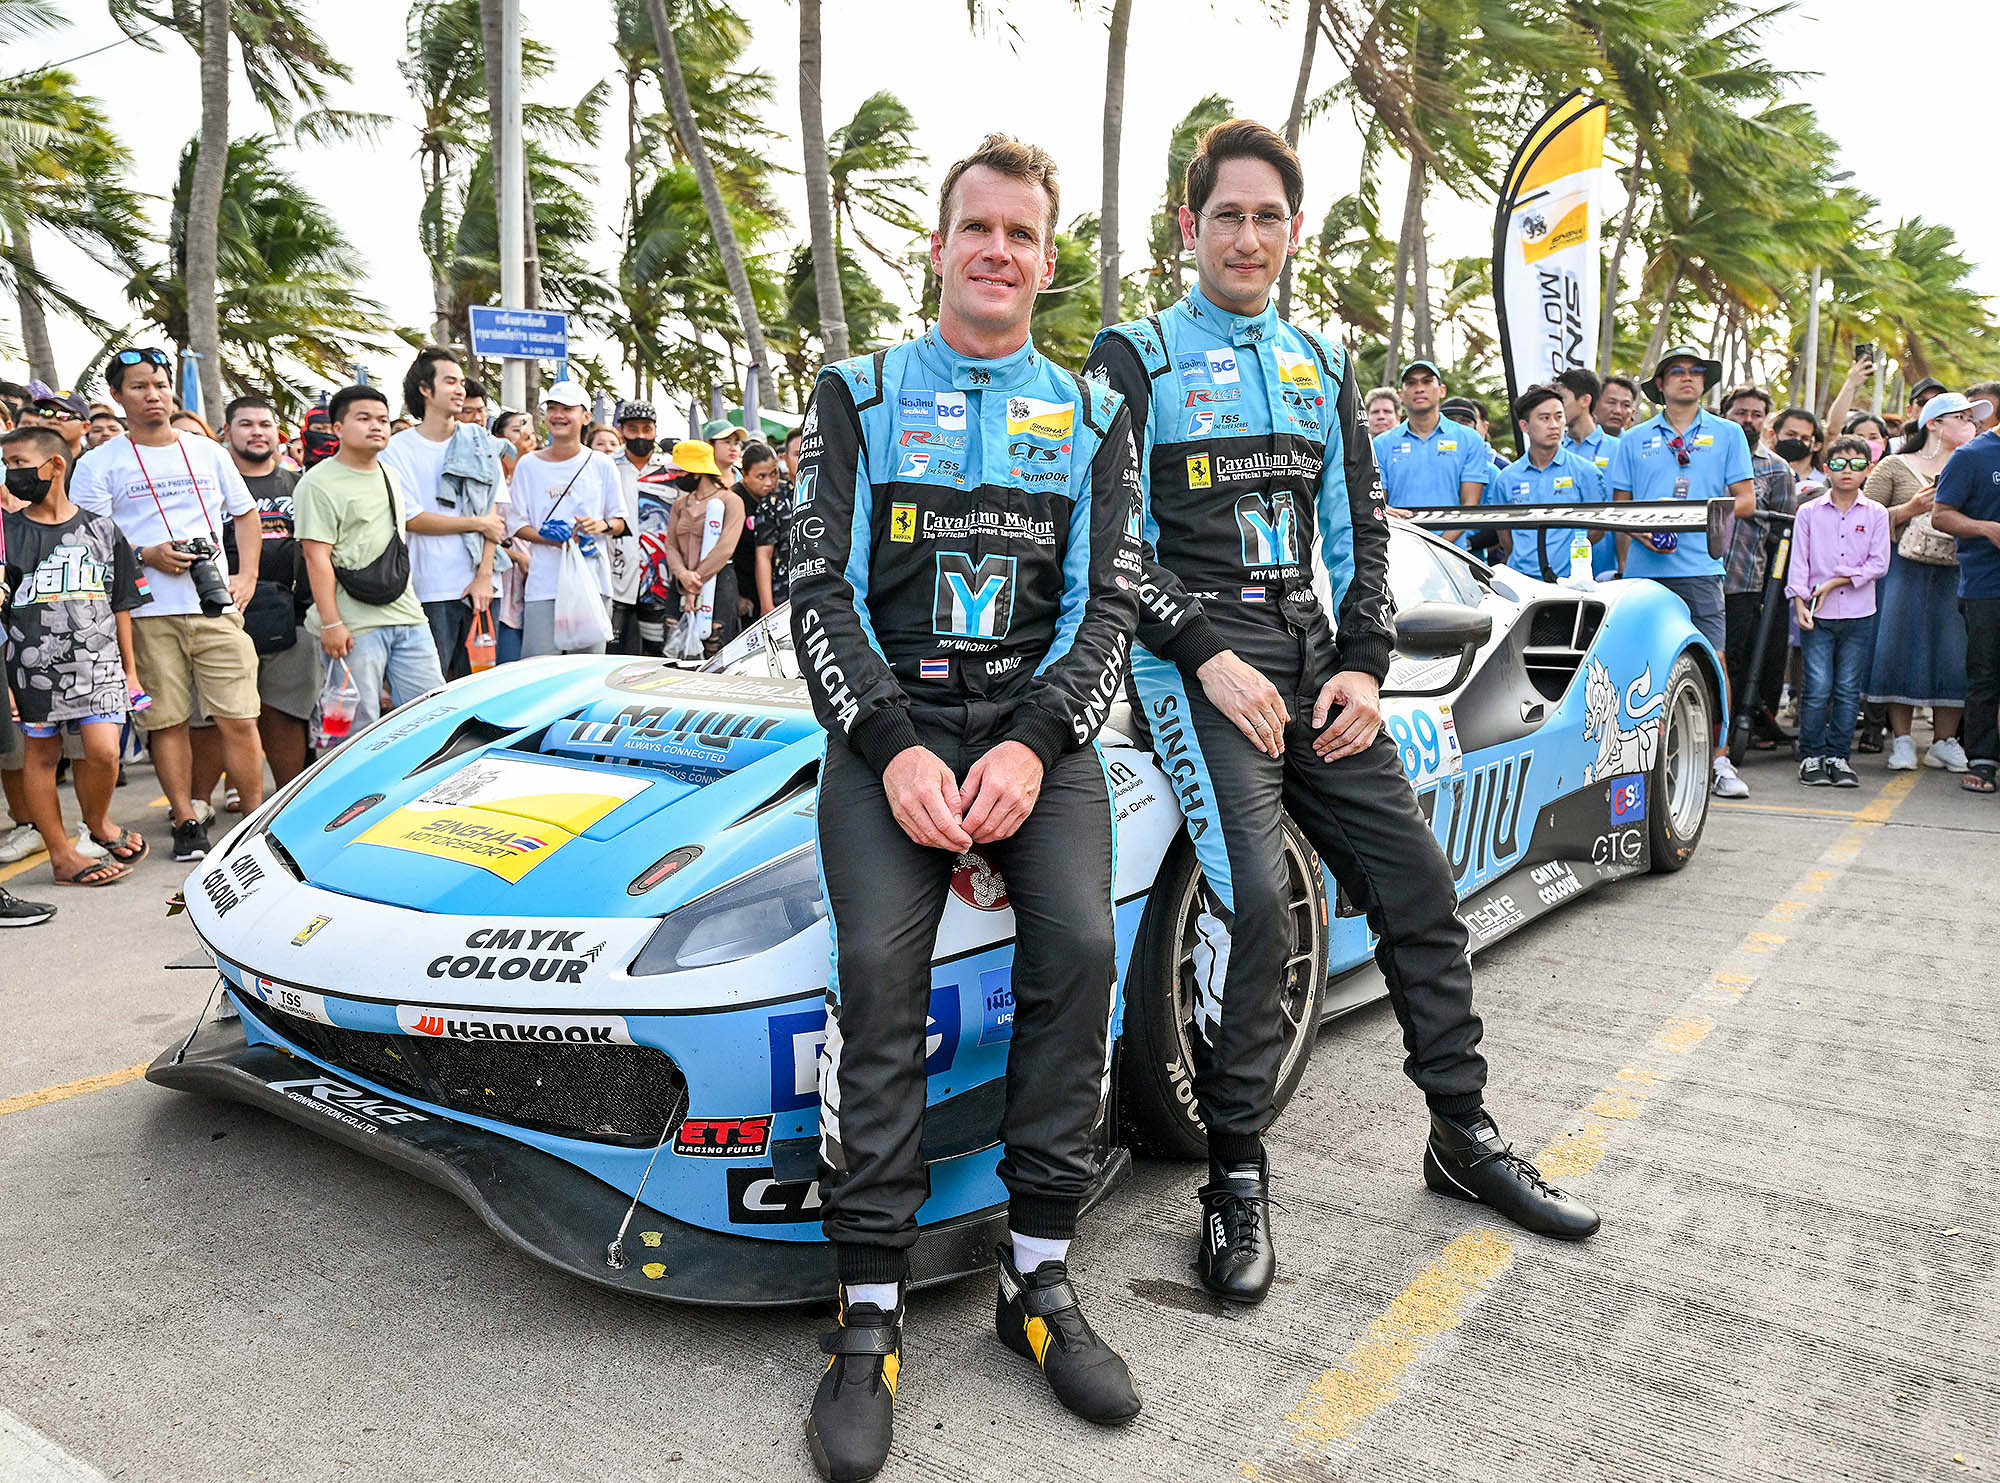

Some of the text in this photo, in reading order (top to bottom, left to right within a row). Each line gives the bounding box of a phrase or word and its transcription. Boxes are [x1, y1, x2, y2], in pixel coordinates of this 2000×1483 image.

[1540, 271, 1564, 381] MOTO
[1565, 275, 1584, 379] SIN
[1210, 359, 1236, 373] BG
[937, 405, 965, 418] BG
[1185, 388, 1242, 408] RACE
[1221, 415, 1240, 424] TSS
[899, 430, 967, 448] RACE
[1008, 442, 1060, 461] CTS
[938, 460, 960, 471] TSS
[801, 608, 860, 735] SINGHA
[1073, 632, 1128, 745] SINGHA
[623, 740, 727, 764] ALWAYS CONNECTED
[1388, 708, 1441, 782] 89
[1153, 695, 1210, 841] SINGHA
[1129, 793, 1156, 813] Drink
[400, 830, 518, 860] MOTORSPORT
[421, 818, 517, 846] SINGHA
[1591, 828, 1642, 866] CTG
[230, 853, 266, 890] CMYK
[1530, 859, 1566, 886] CMYK
[201, 868, 240, 918] COLOUR
[1538, 876, 1583, 905] COLOUR
[465, 928, 586, 952] CMYK
[426, 955, 588, 984] COLOUR
[280, 990, 302, 1008] TSS
[265, 1074, 430, 1126] RACE
[287, 1091, 343, 1120] CONNECTION
[680, 1118, 771, 1145] ETS
[678, 1144, 763, 1155] RACING FUELS
